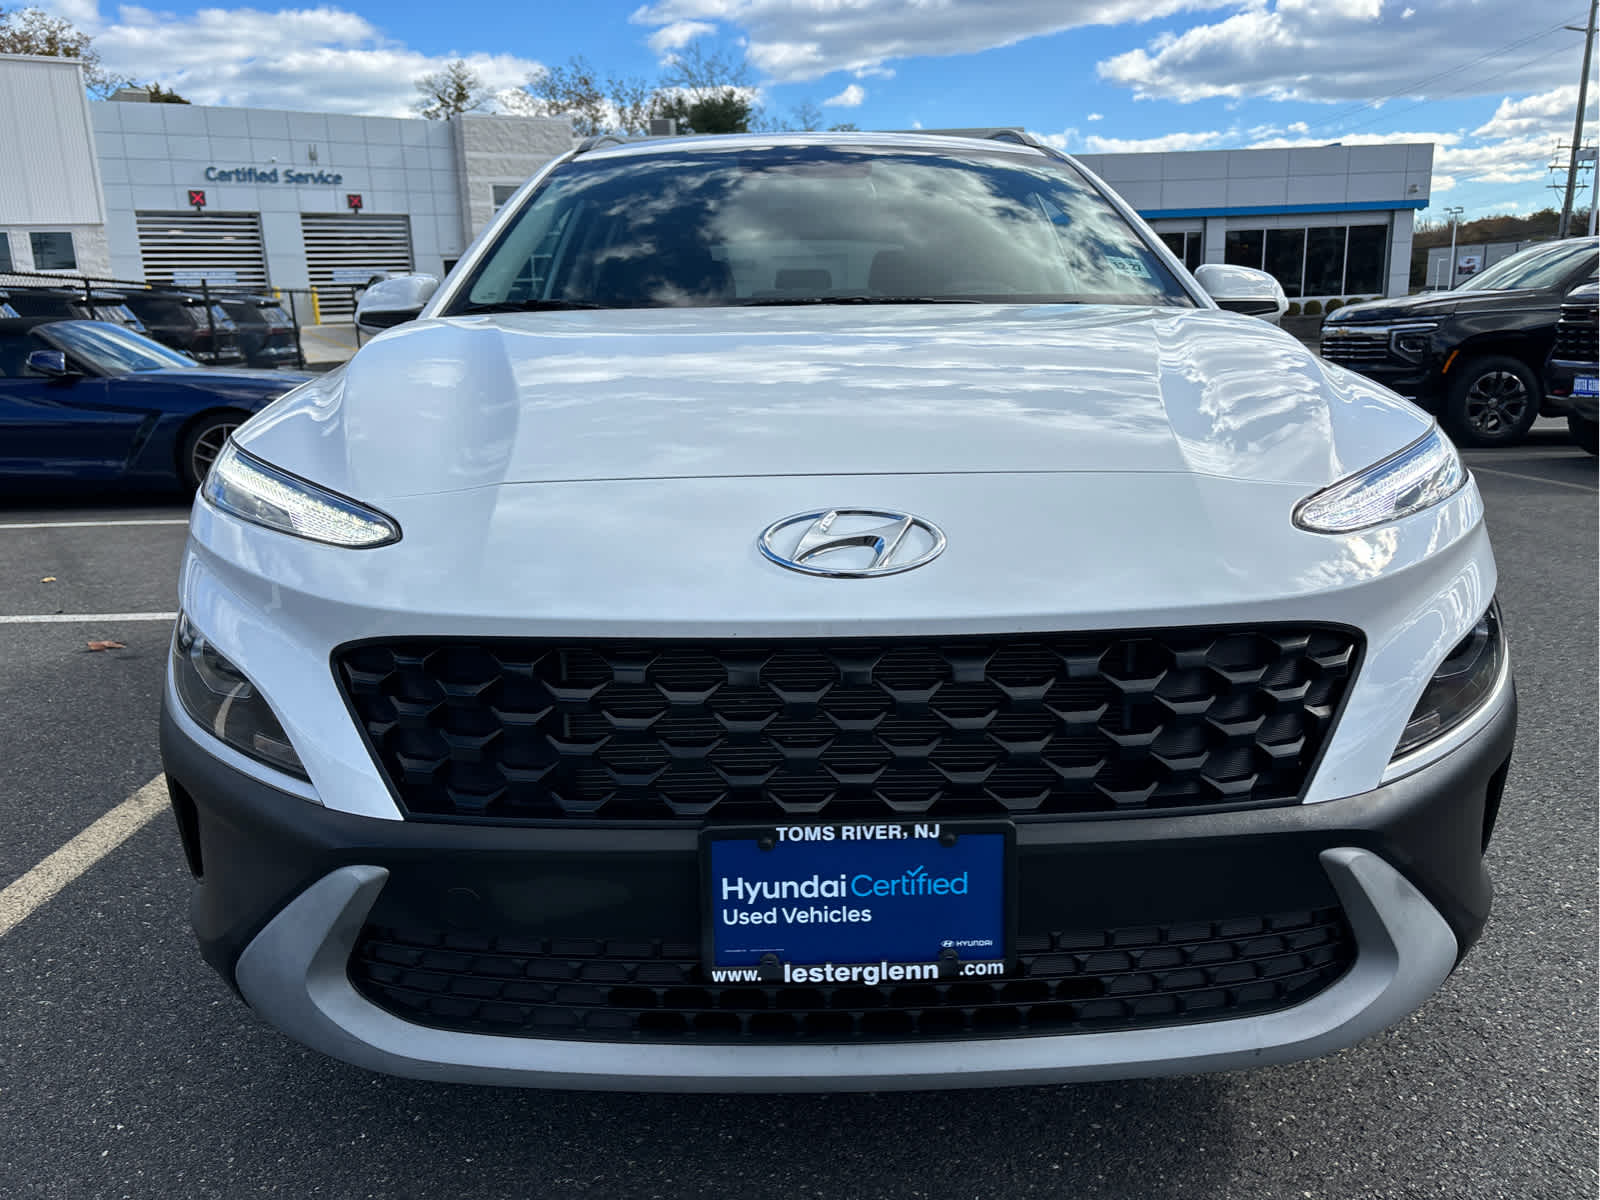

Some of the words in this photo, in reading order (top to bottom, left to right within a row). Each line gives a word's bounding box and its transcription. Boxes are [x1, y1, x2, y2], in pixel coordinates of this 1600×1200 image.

[205, 166, 278, 183] Certified
[284, 169, 343, 185] Service
[776, 826, 835, 842] TOMS
[841, 825, 908, 840] RIVER,
[914, 824, 940, 839] NJ
[721, 874, 847, 904] Hyundai
[851, 866, 968, 897] Certified
[723, 907, 777, 925] Used
[781, 905, 872, 924] Vehicles
[956, 939, 993, 947] HYUNDAI
[711, 968, 762, 983] www.
[784, 961, 939, 985] lesterglenn
[959, 961, 1004, 976] .com
